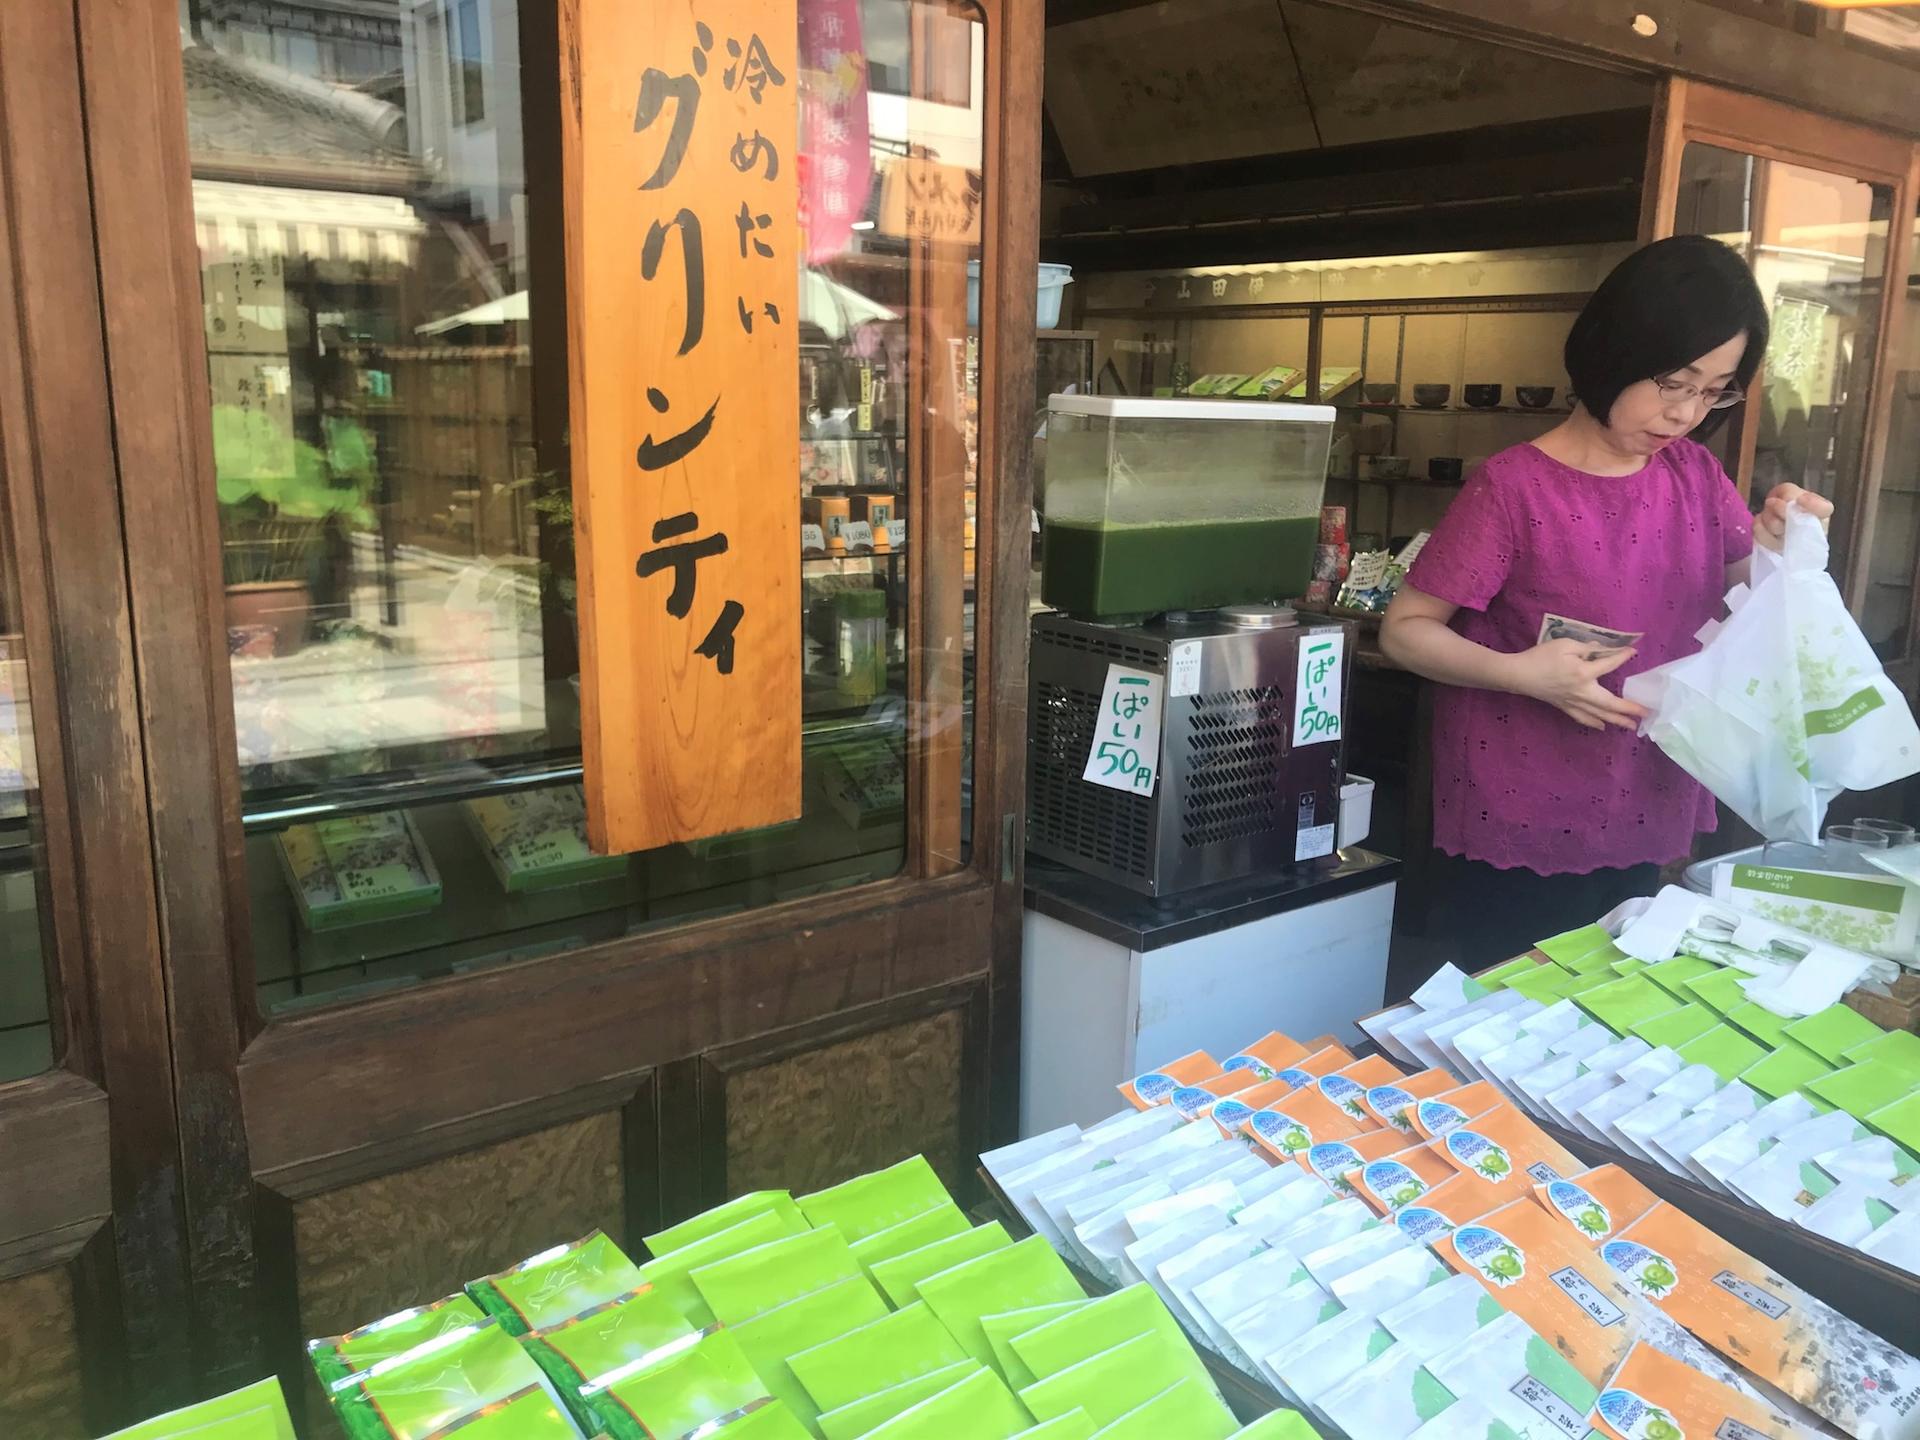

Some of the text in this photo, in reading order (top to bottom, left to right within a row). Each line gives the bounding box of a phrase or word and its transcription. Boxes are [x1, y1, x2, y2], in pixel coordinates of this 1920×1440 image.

[723, 33, 787, 334] 冷めたい
[633, 21, 745, 676] グリンティ
[1304, 642, 1337, 706] 一ぱい
[1112, 677, 1150, 740] 一ぱい
[1300, 705, 1340, 741] 50円
[1096, 741, 1153, 789] 50円
